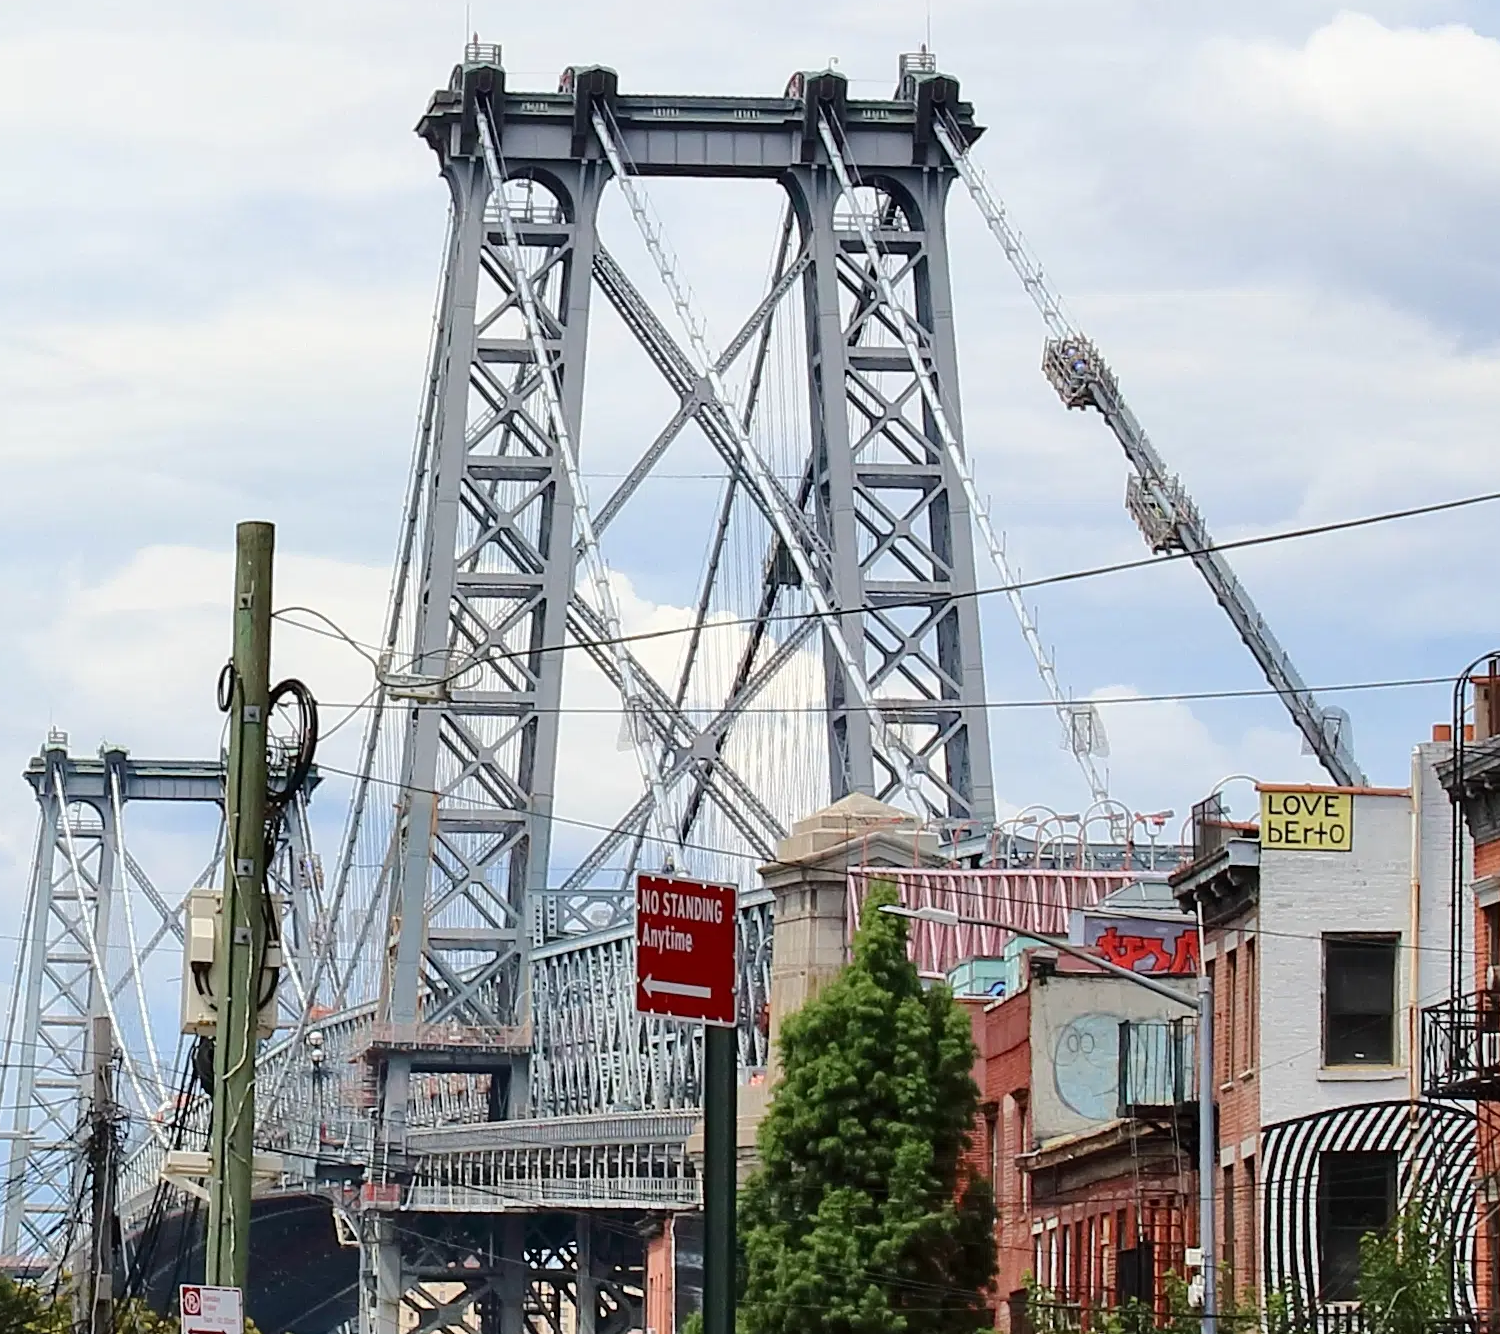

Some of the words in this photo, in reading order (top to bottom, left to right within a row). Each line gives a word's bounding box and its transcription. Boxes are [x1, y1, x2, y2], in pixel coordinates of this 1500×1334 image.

[1267, 794, 1341, 817] LOVE
[641, 888, 660, 915] NO
[662, 891, 723, 924] STANDING
[641, 921, 694, 955] Anytime
